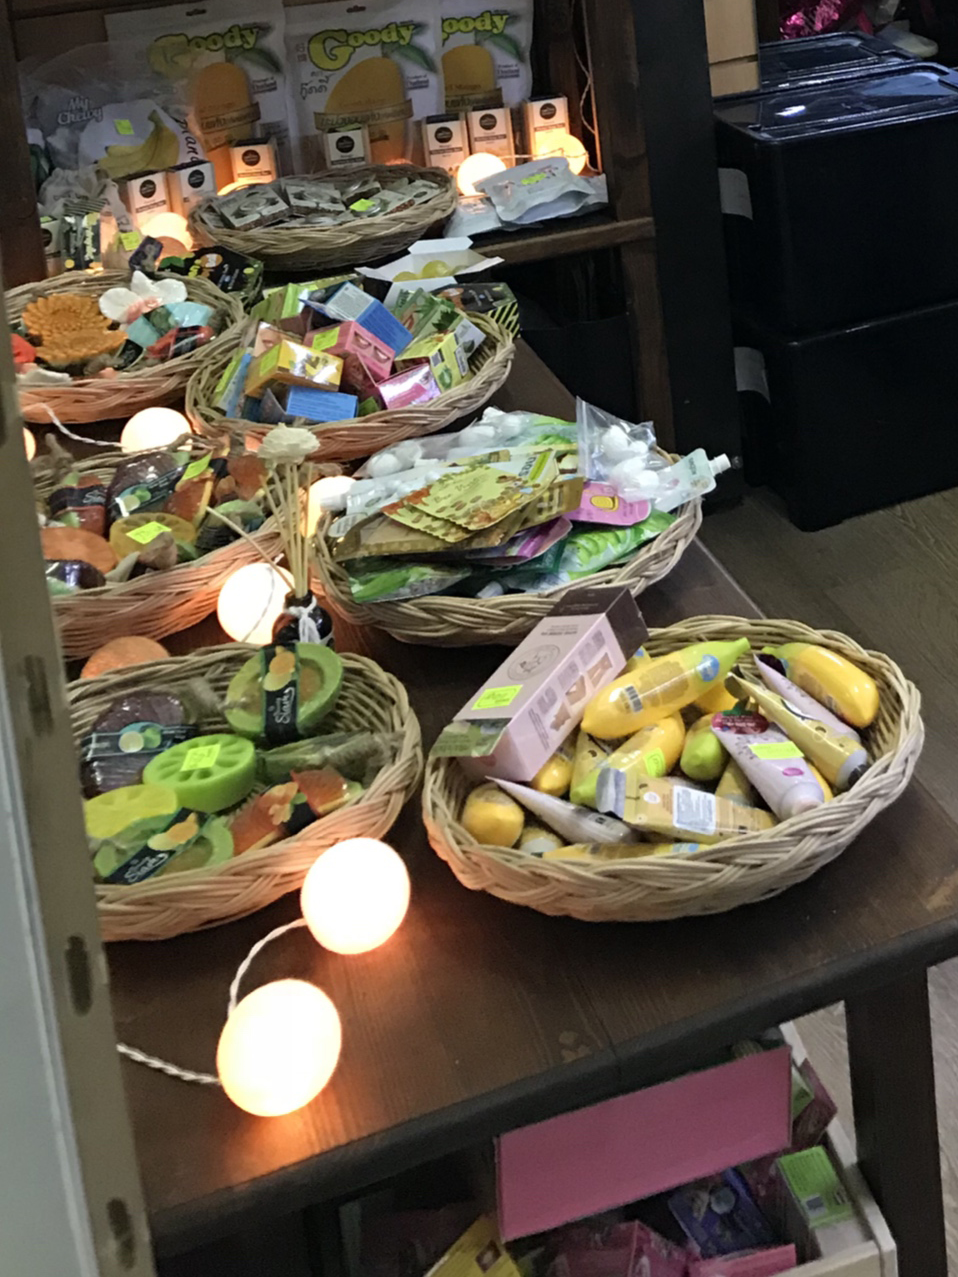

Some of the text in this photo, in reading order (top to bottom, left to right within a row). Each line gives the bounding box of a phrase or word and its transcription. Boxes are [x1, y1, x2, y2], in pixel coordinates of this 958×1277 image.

[148, 23, 259, 78] Goody
[307, 21, 416, 72] Goody
[57, 106, 104, 126] Chewy
[68, 95, 91, 112] My
